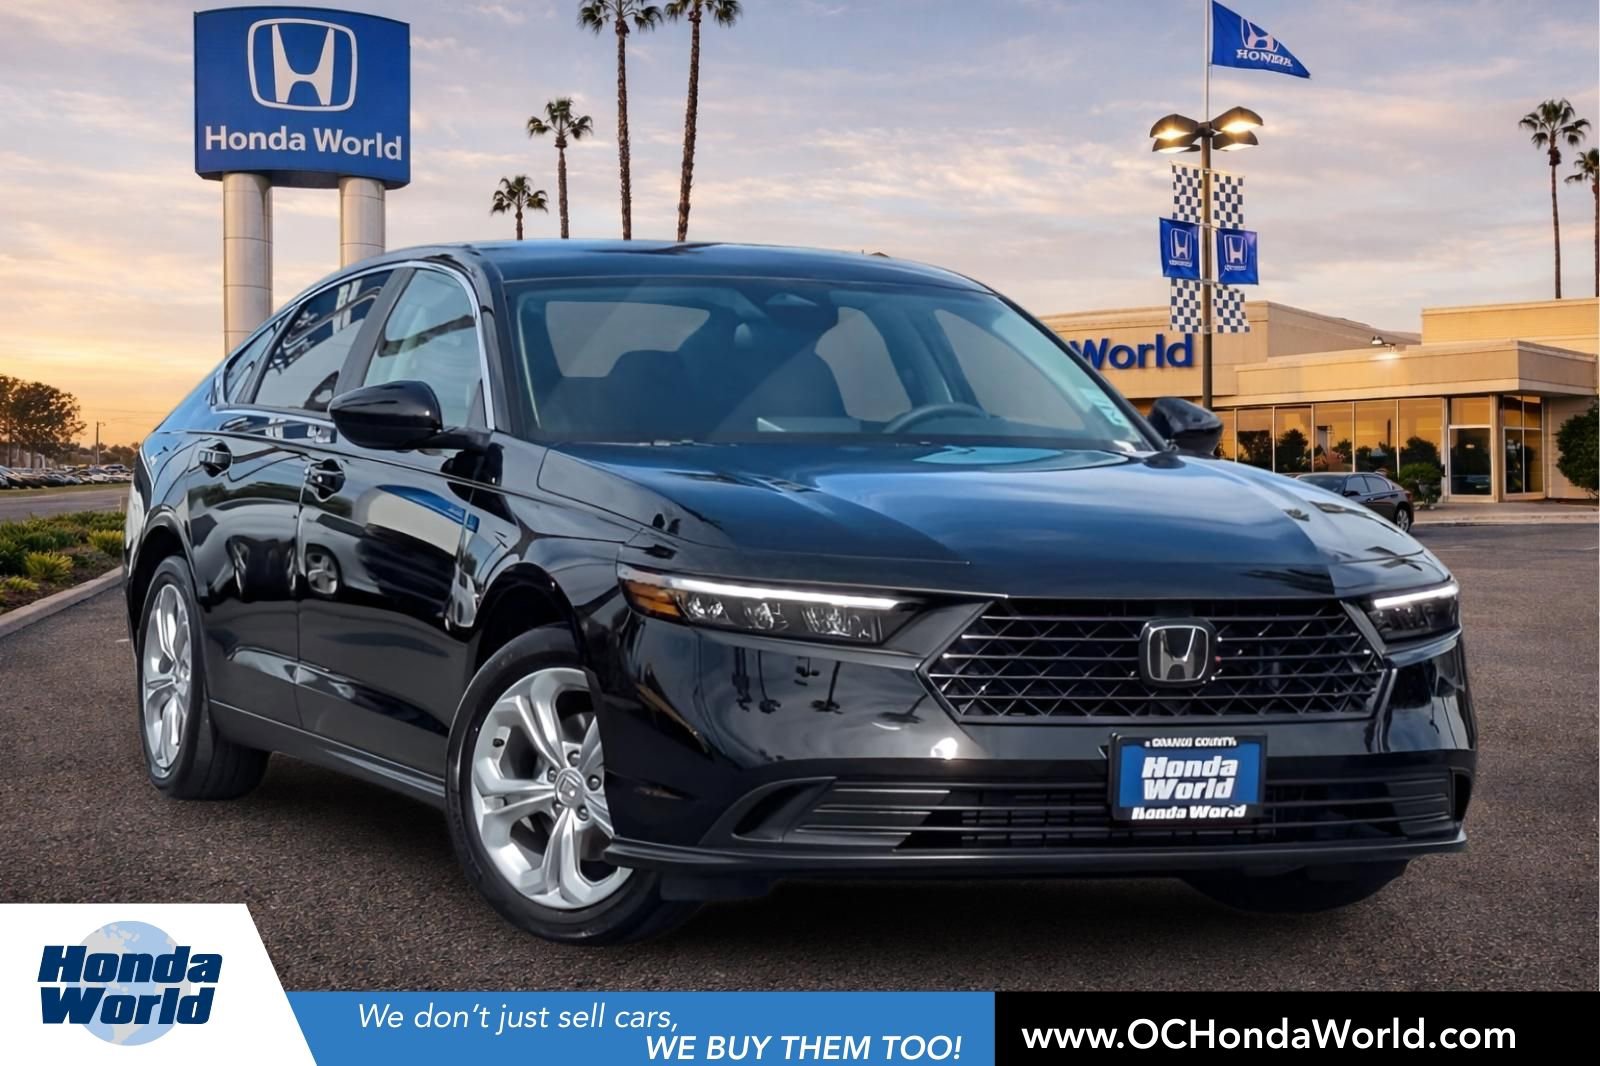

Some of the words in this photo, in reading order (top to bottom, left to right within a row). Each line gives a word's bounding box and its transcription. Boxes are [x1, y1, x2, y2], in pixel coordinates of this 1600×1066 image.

[205, 125, 306, 151] Honda
[313, 127, 402, 161] World
[1069, 333, 1195, 370] World
[1142, 755, 1239, 778] Honda
[1143, 777, 1236, 801] World
